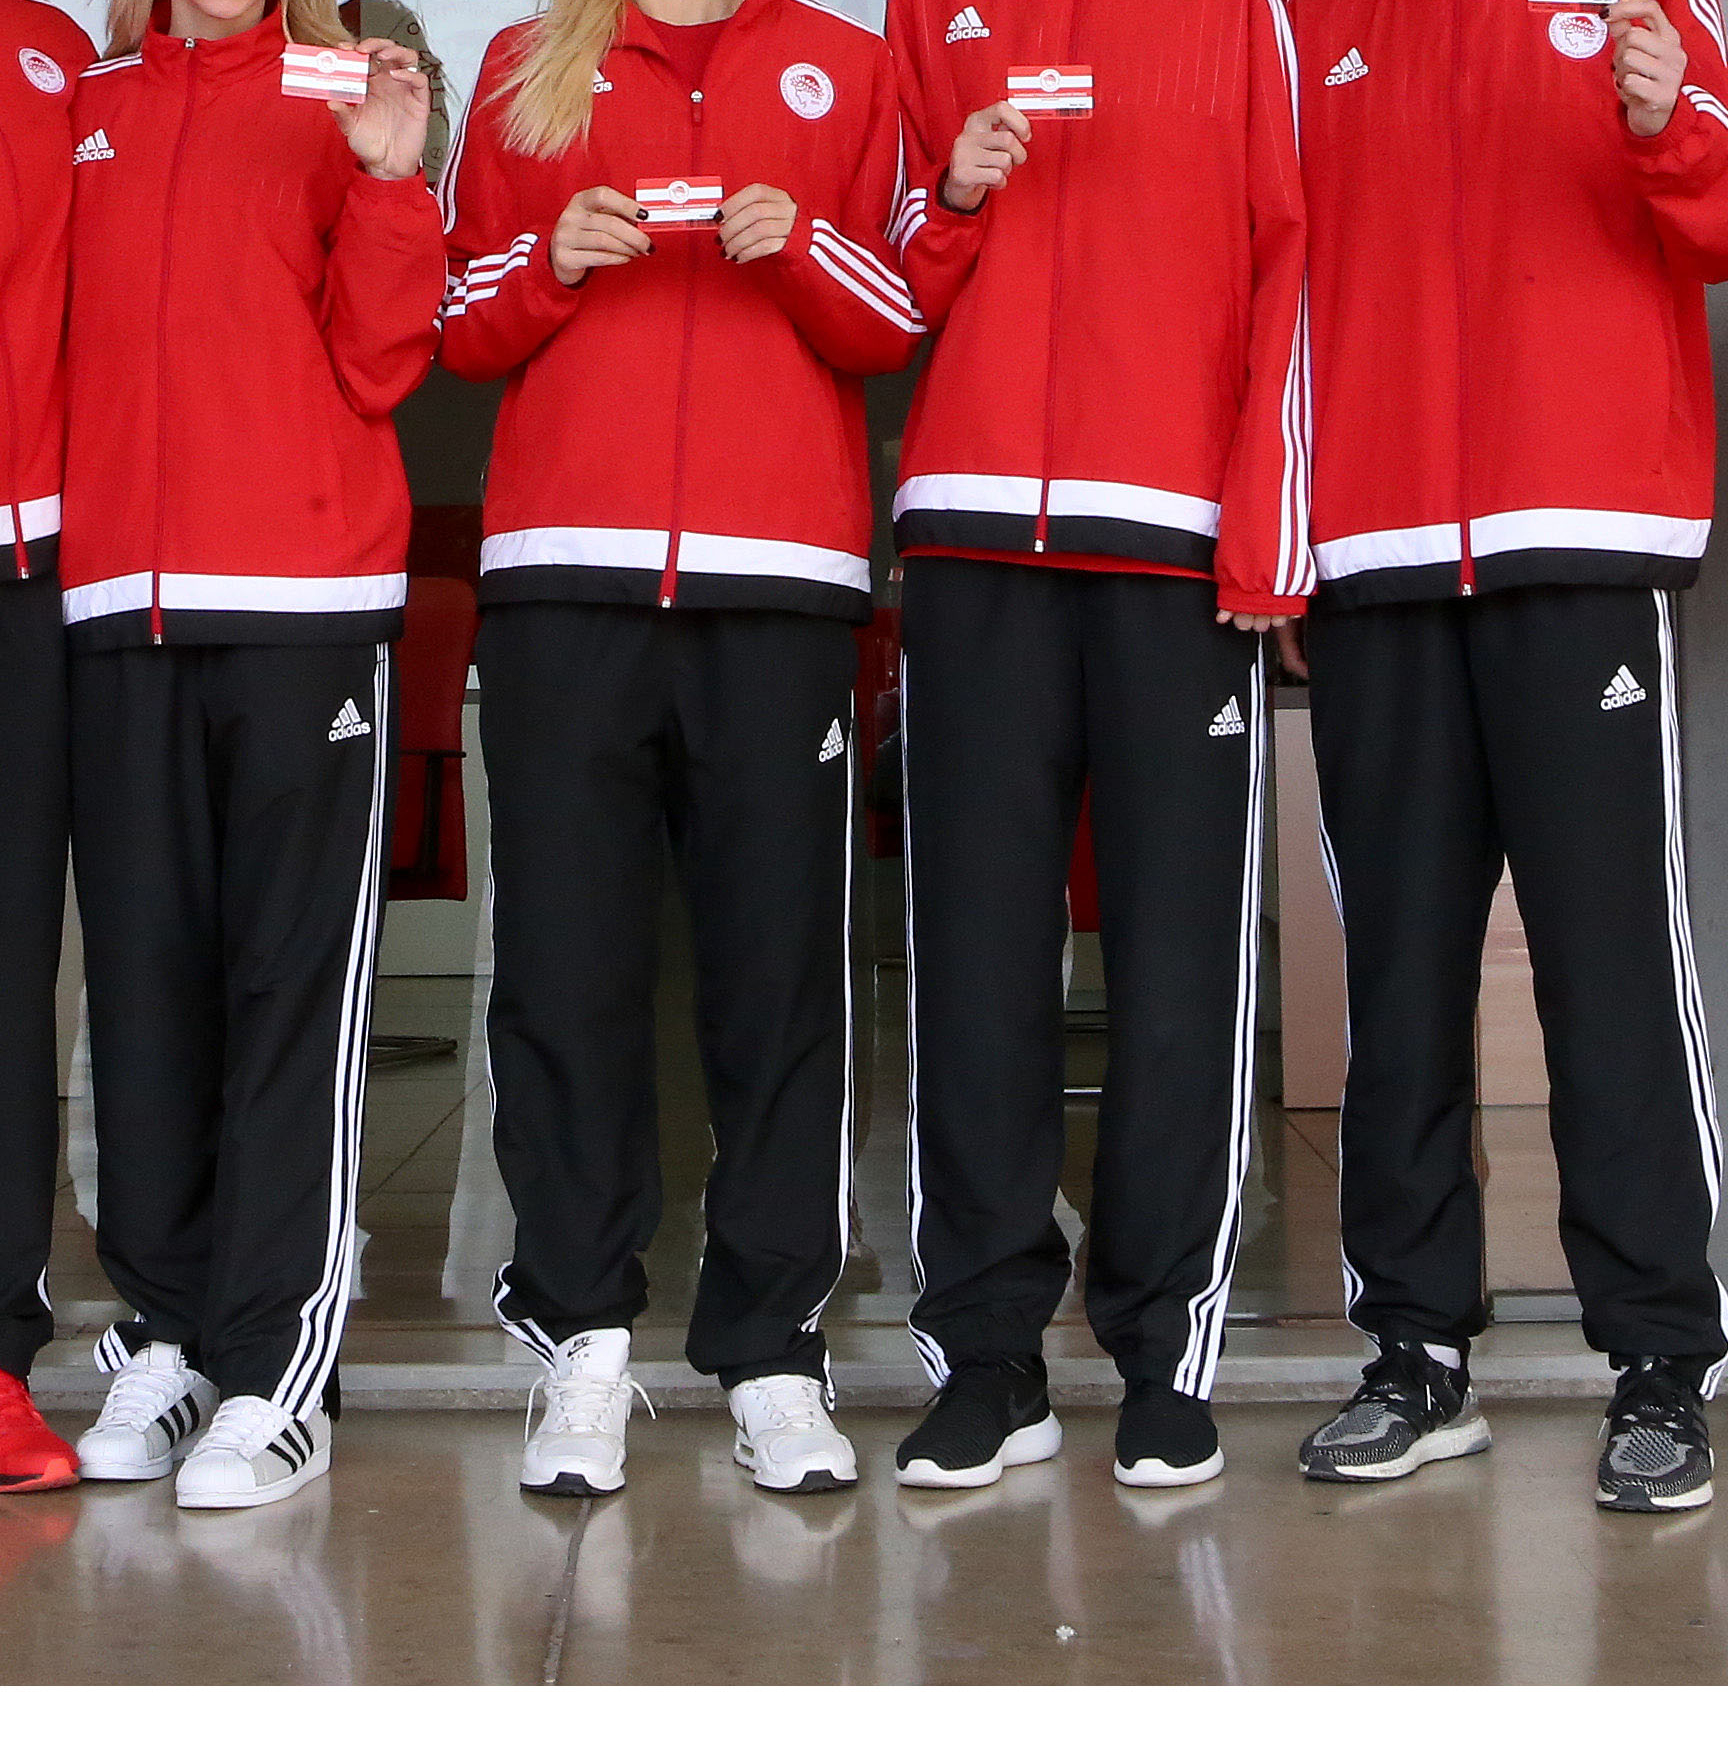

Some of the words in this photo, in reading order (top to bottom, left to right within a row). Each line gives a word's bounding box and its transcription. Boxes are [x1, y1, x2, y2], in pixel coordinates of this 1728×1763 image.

[946, 27, 991, 44] adidas
[1325, 65, 1369, 85] adidas
[1601, 688, 1647, 710] adidas
[328, 722, 371, 741] adidas
